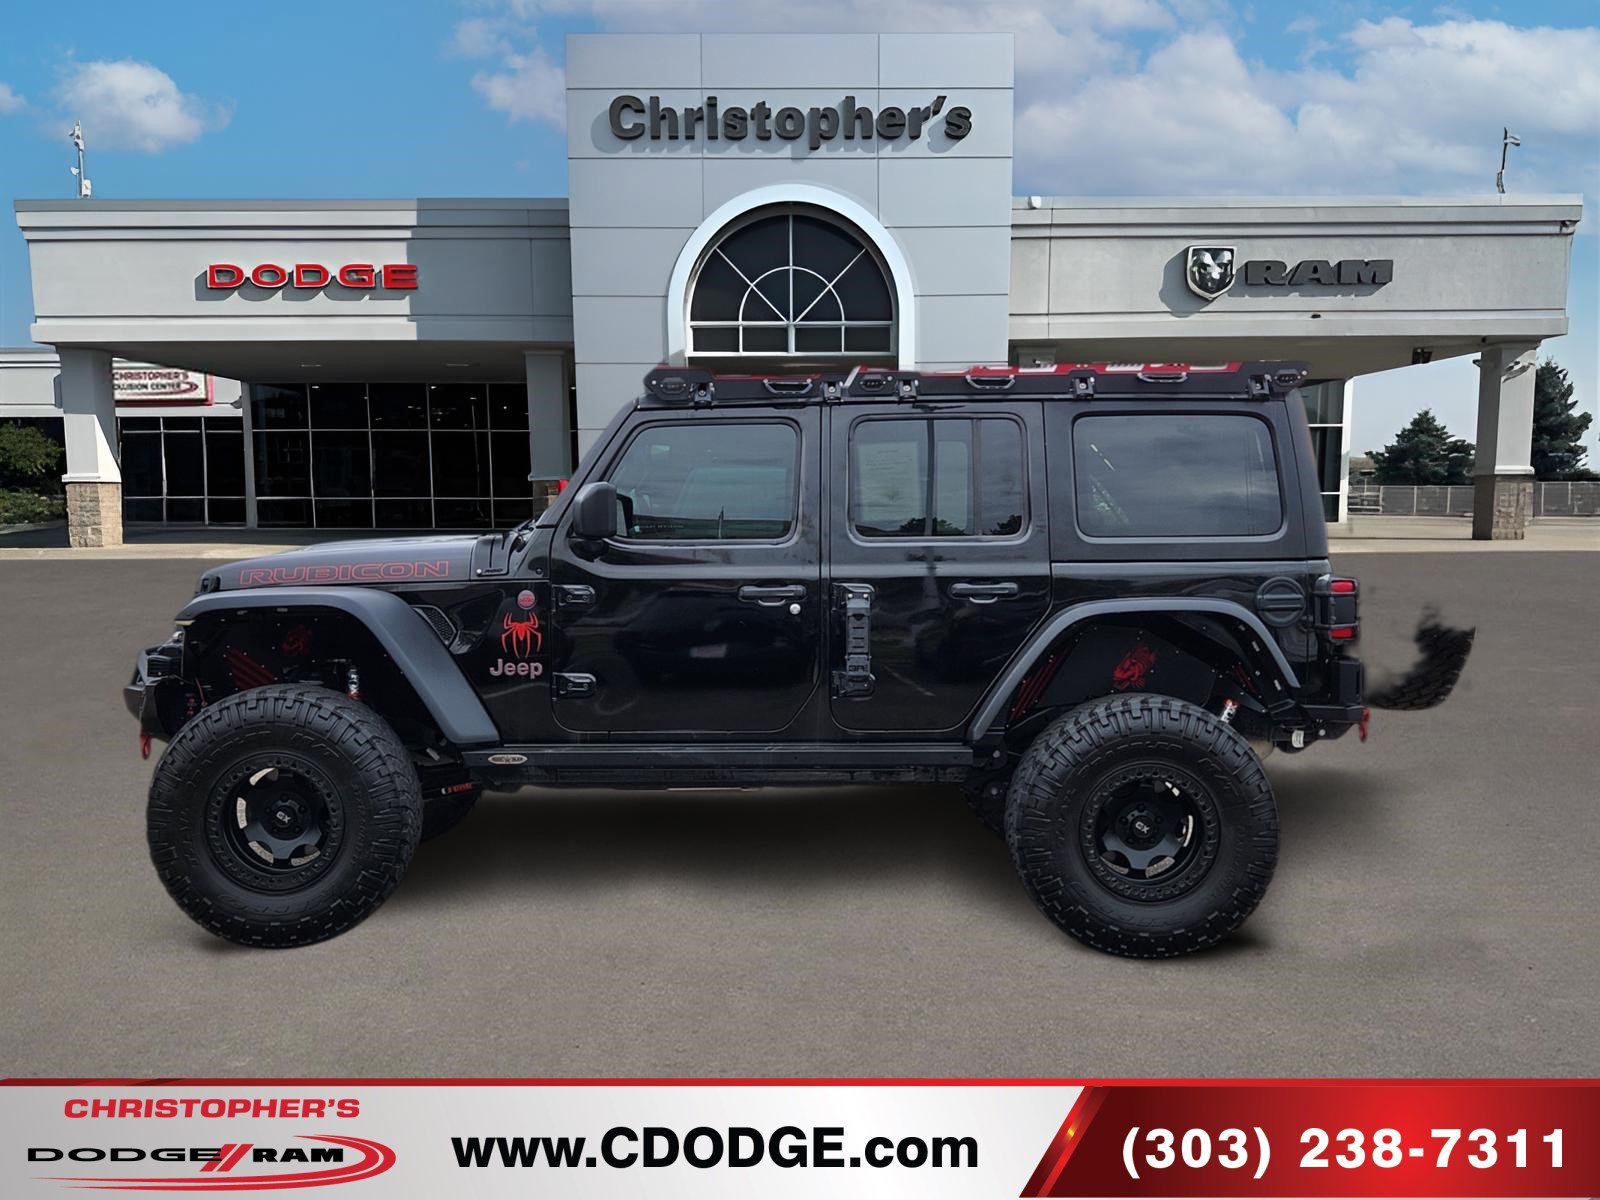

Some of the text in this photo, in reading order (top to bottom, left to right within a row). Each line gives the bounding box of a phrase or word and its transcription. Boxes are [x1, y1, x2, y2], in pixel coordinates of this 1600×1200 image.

[608, 94, 972, 150] Christopher's
[206, 263, 417, 289] DODGE
[1246, 259, 1393, 285] RAM
[113, 382, 181, 391] OLLISION CENTER
[239, 560, 449, 585] RUBICON
[489, 658, 543, 679] Jeep
